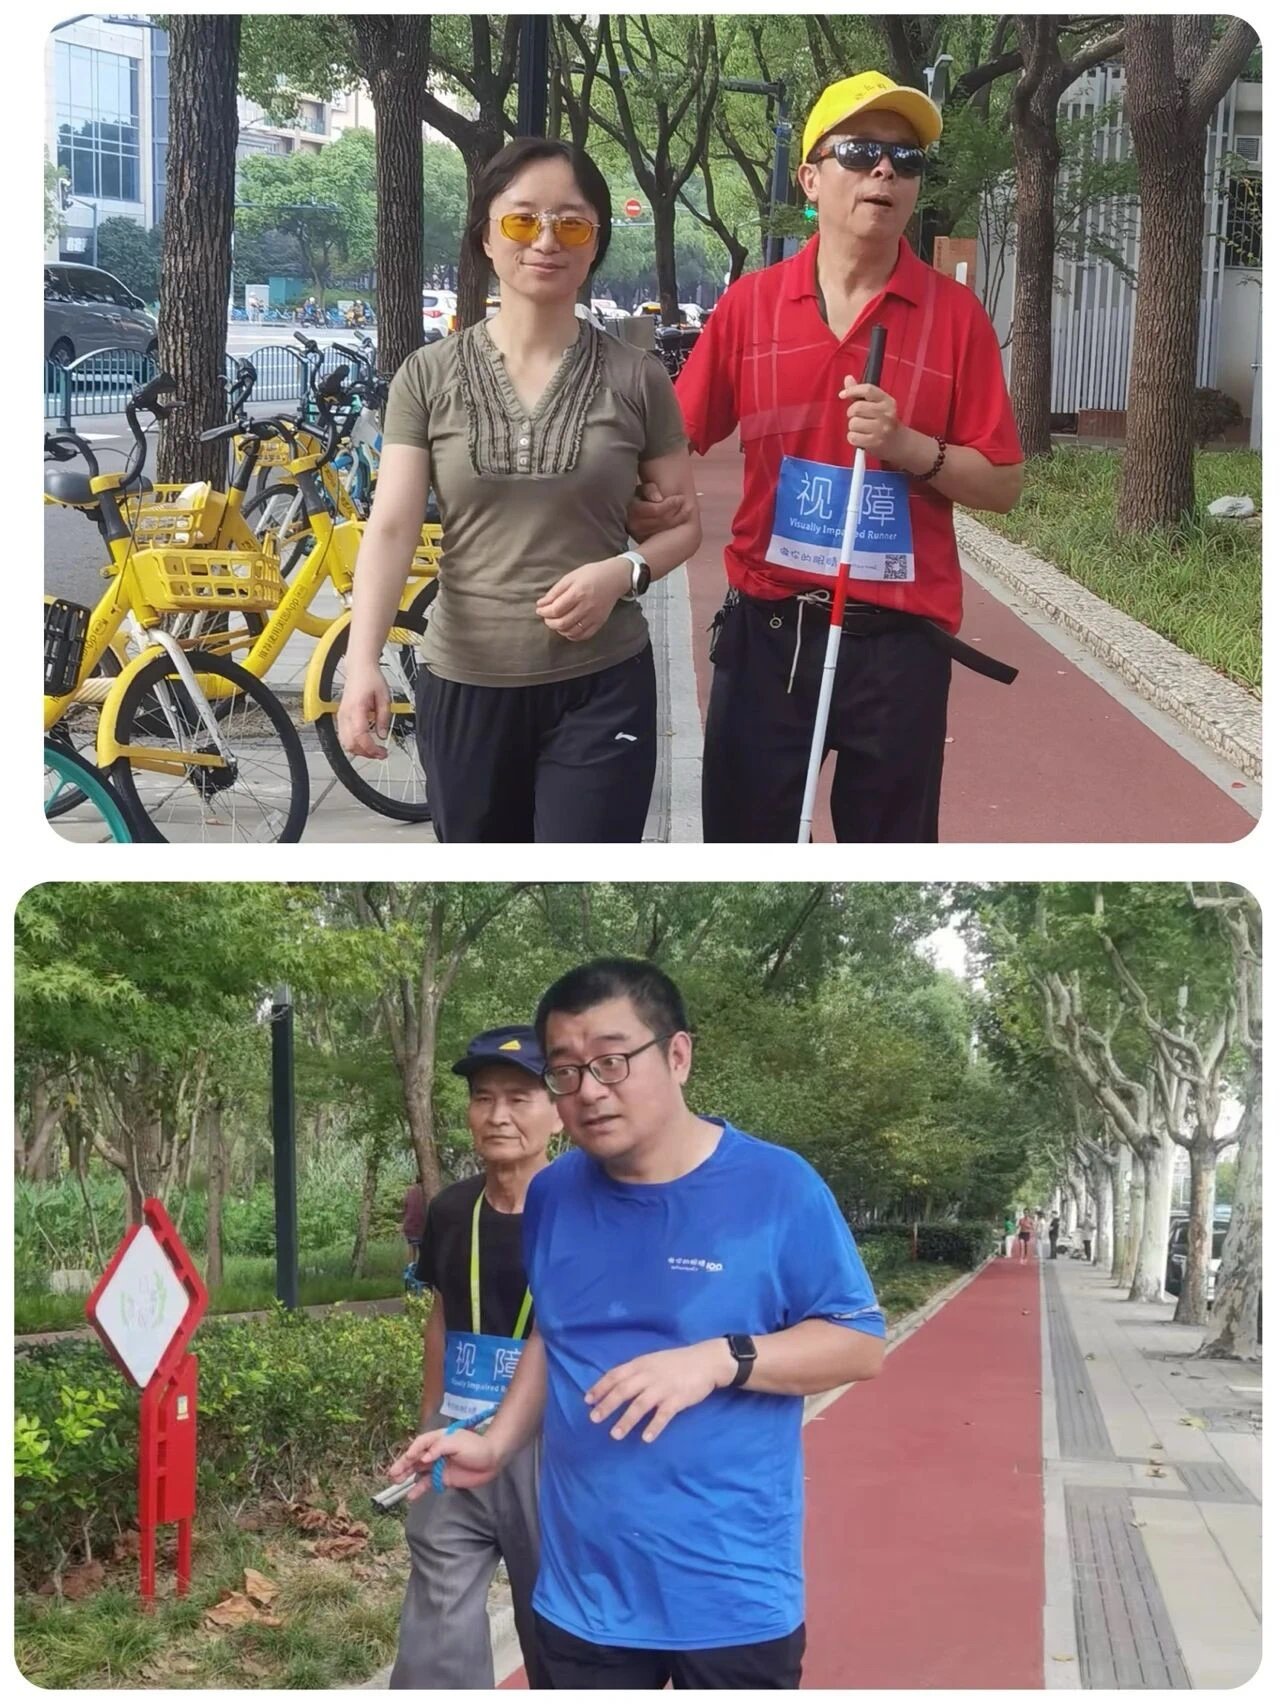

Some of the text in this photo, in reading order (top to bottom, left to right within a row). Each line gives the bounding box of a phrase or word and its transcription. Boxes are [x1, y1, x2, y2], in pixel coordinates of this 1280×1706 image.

[796, 471, 896, 527] 视障
[789, 516, 821, 535] Visually
[867, 530, 897, 541] Runner
